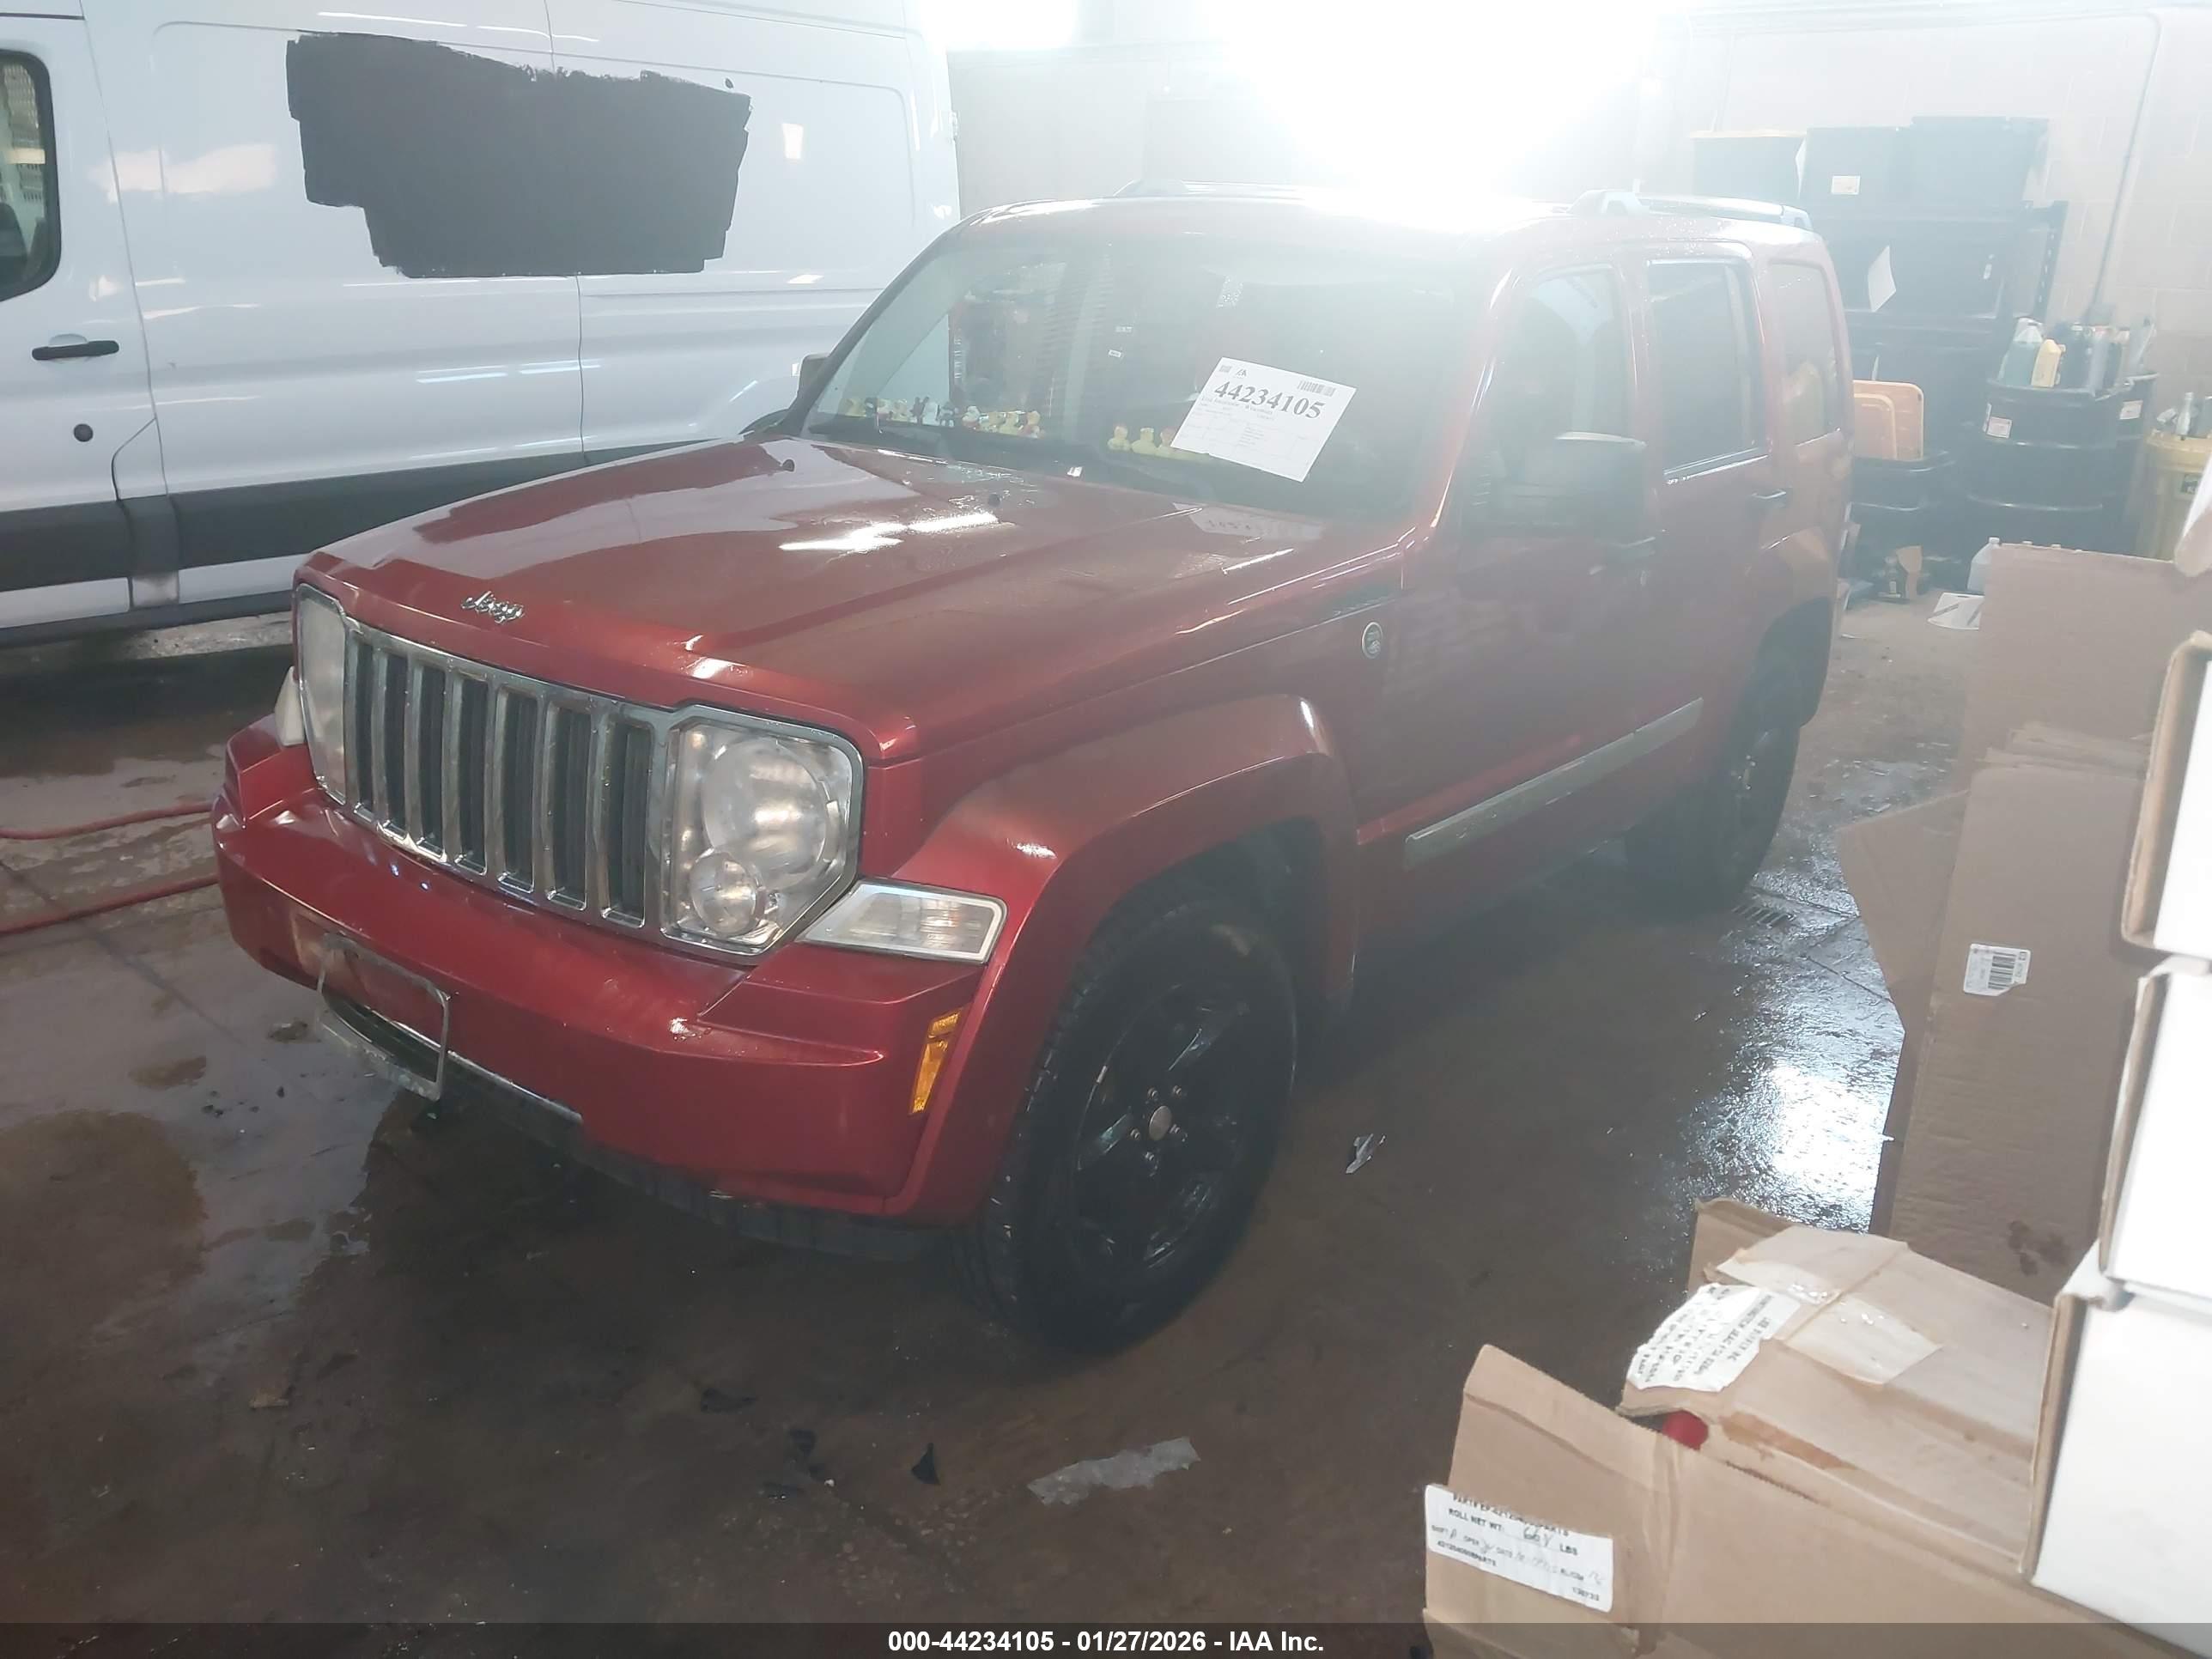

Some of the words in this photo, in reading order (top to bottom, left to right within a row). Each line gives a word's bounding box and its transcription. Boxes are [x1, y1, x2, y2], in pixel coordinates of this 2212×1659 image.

[1214, 381, 1326, 418] 44234105
[460, 591, 525, 623] Jeep
[1449, 1508, 1468, 1522] ROLL
[1559, 1543, 1578, 1556] LBS
